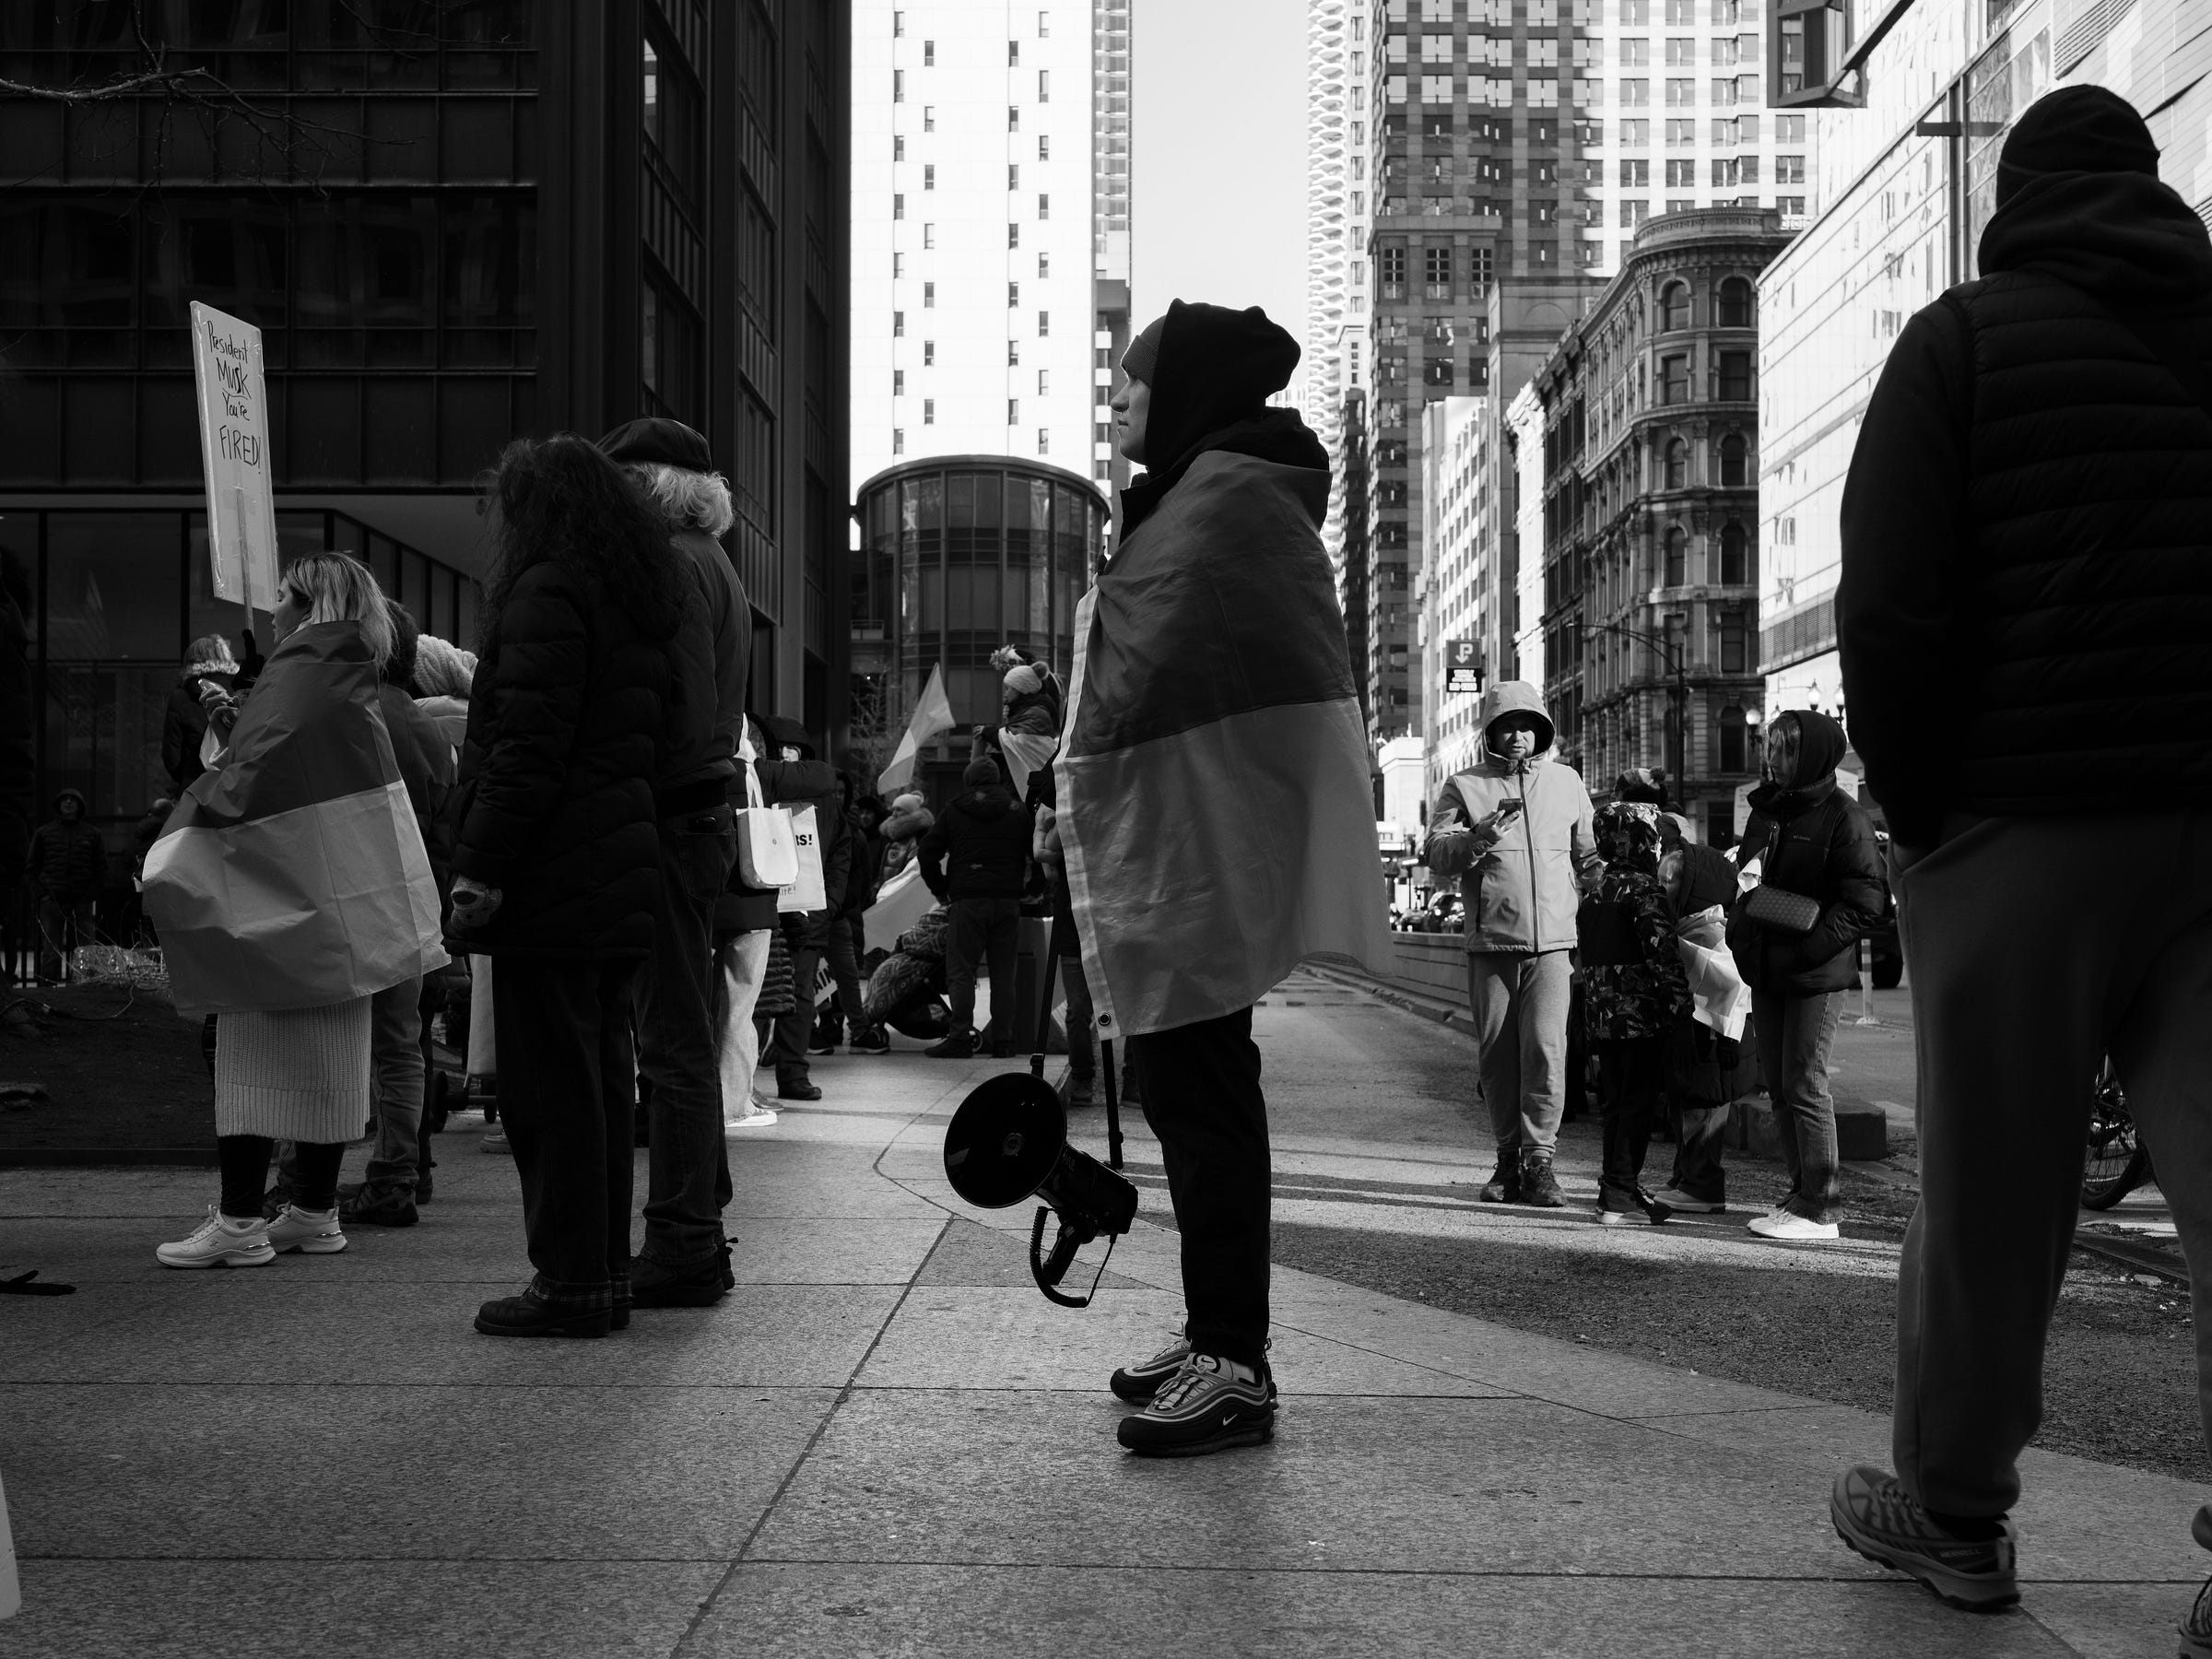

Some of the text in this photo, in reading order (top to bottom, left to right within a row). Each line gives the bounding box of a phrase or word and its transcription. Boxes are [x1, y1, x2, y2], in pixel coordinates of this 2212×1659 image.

[206, 320, 248, 364] President
[222, 392, 251, 421] You're
[219, 425, 262, 476] FIRED!
